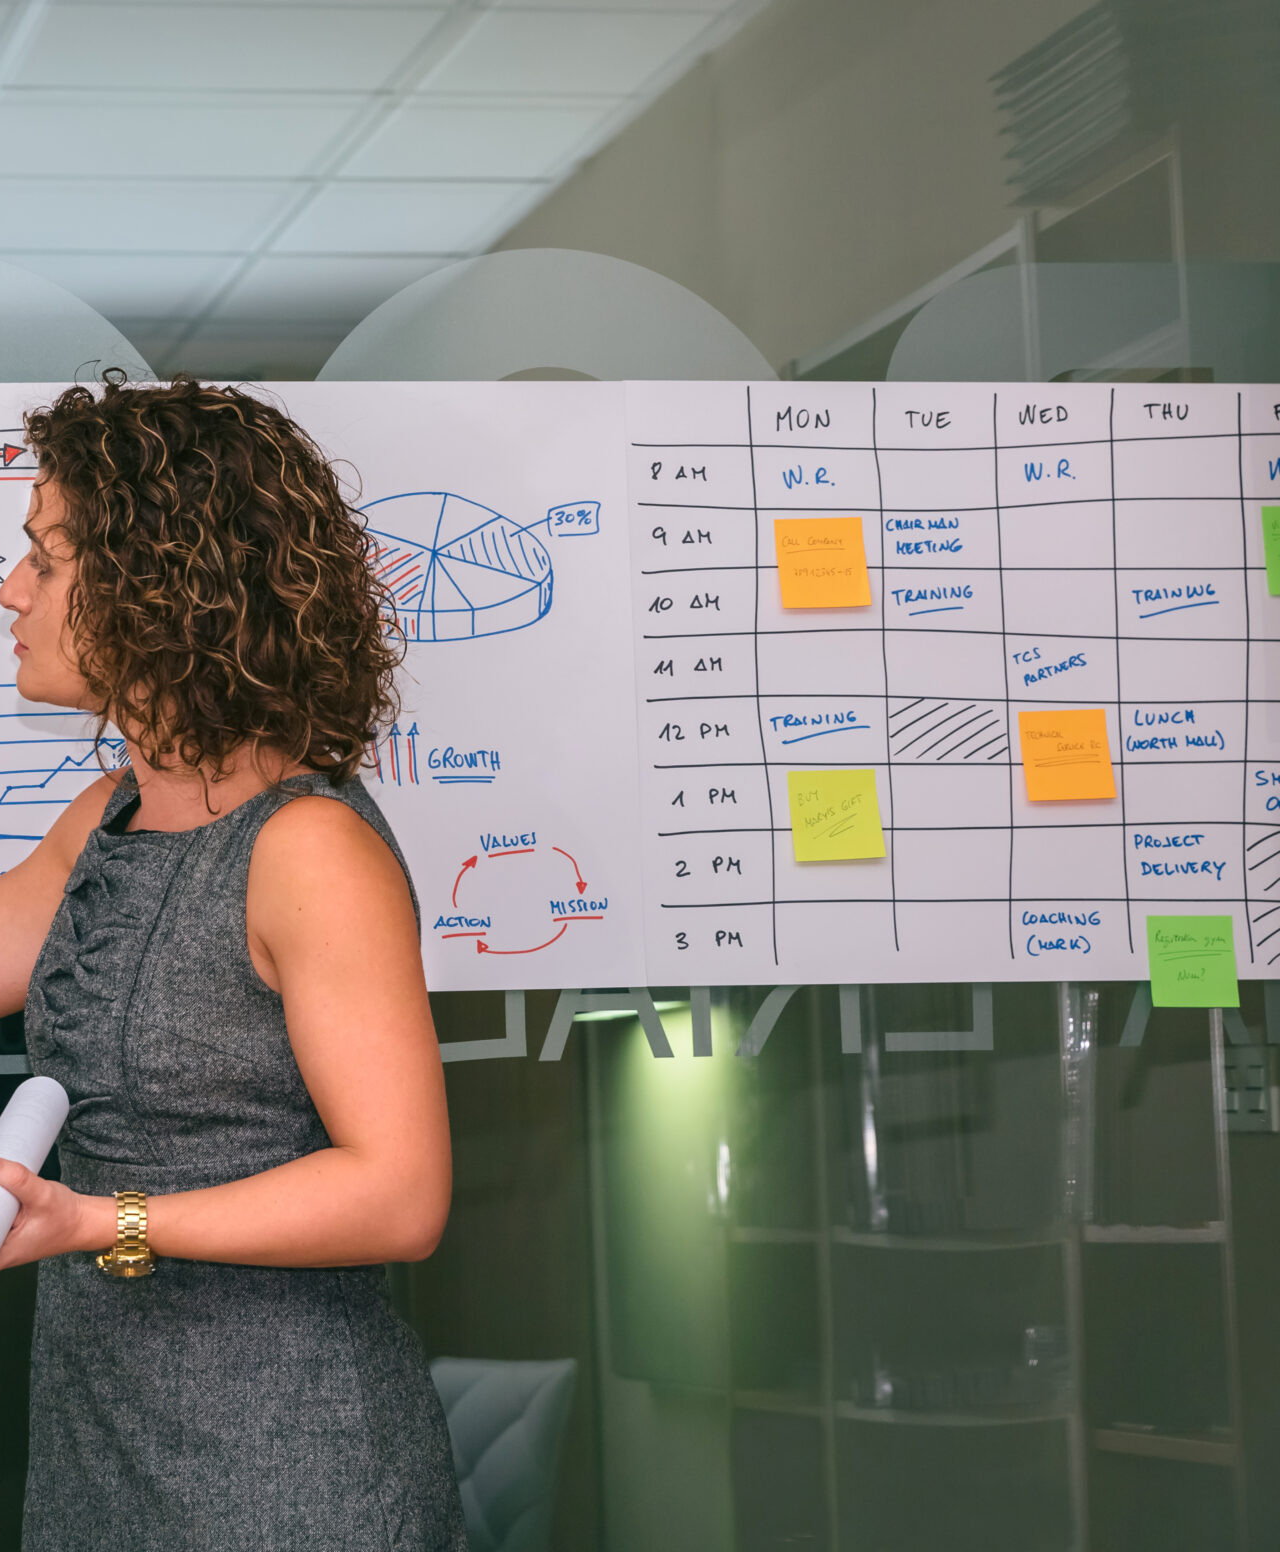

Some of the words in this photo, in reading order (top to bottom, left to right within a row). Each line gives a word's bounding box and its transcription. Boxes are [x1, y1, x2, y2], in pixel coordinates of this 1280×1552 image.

[776, 405, 831, 432] MON
[904, 410, 952, 430] TUE
[1018, 404, 1069, 426] WED
[1143, 402, 1189, 421] THU
[650, 461, 663, 481] 8
[674, 465, 708, 482] AM
[782, 464, 836, 490] W.R.
[1023, 458, 1076, 483] W.R.
[551, 508, 594, 528] 30%
[651, 526, 668, 547] 9
[681, 528, 713, 545] AM
[895, 537, 964, 556] MEETING
[648, 596, 674, 614] 10
[689, 592, 721, 612] AM
[890, 584, 974, 609] TRAINING
[693, 656, 723, 672] AM
[1012, 647, 1042, 665] TCS
[1021, 651, 1088, 687] PARTNERS
[769, 709, 858, 731] TRAINING
[1134, 709, 1196, 727] LUNCH
[658, 722, 686, 742] 12
[699, 722, 730, 740] PM
[1125, 735, 1179, 753] (NORTH
[427, 746, 501, 772] GROWTH
[671, 790, 685, 808] 1
[708, 787, 738, 805] PM
[479, 831, 537, 853] VALUES
[1133, 833, 1206, 850] PROJECT
[674, 859, 692, 878] 2
[711, 855, 742, 876] PM
[1140, 860, 1227, 881] DELIVERY
[549, 897, 609, 916] MISSION
[432, 915, 492, 930] ACTION
[1021, 910, 1101, 927] COACHING
[675, 931, 690, 951] 3
[715, 929, 744, 948] PM
[1026, 934, 1092, 957] (MARK)
